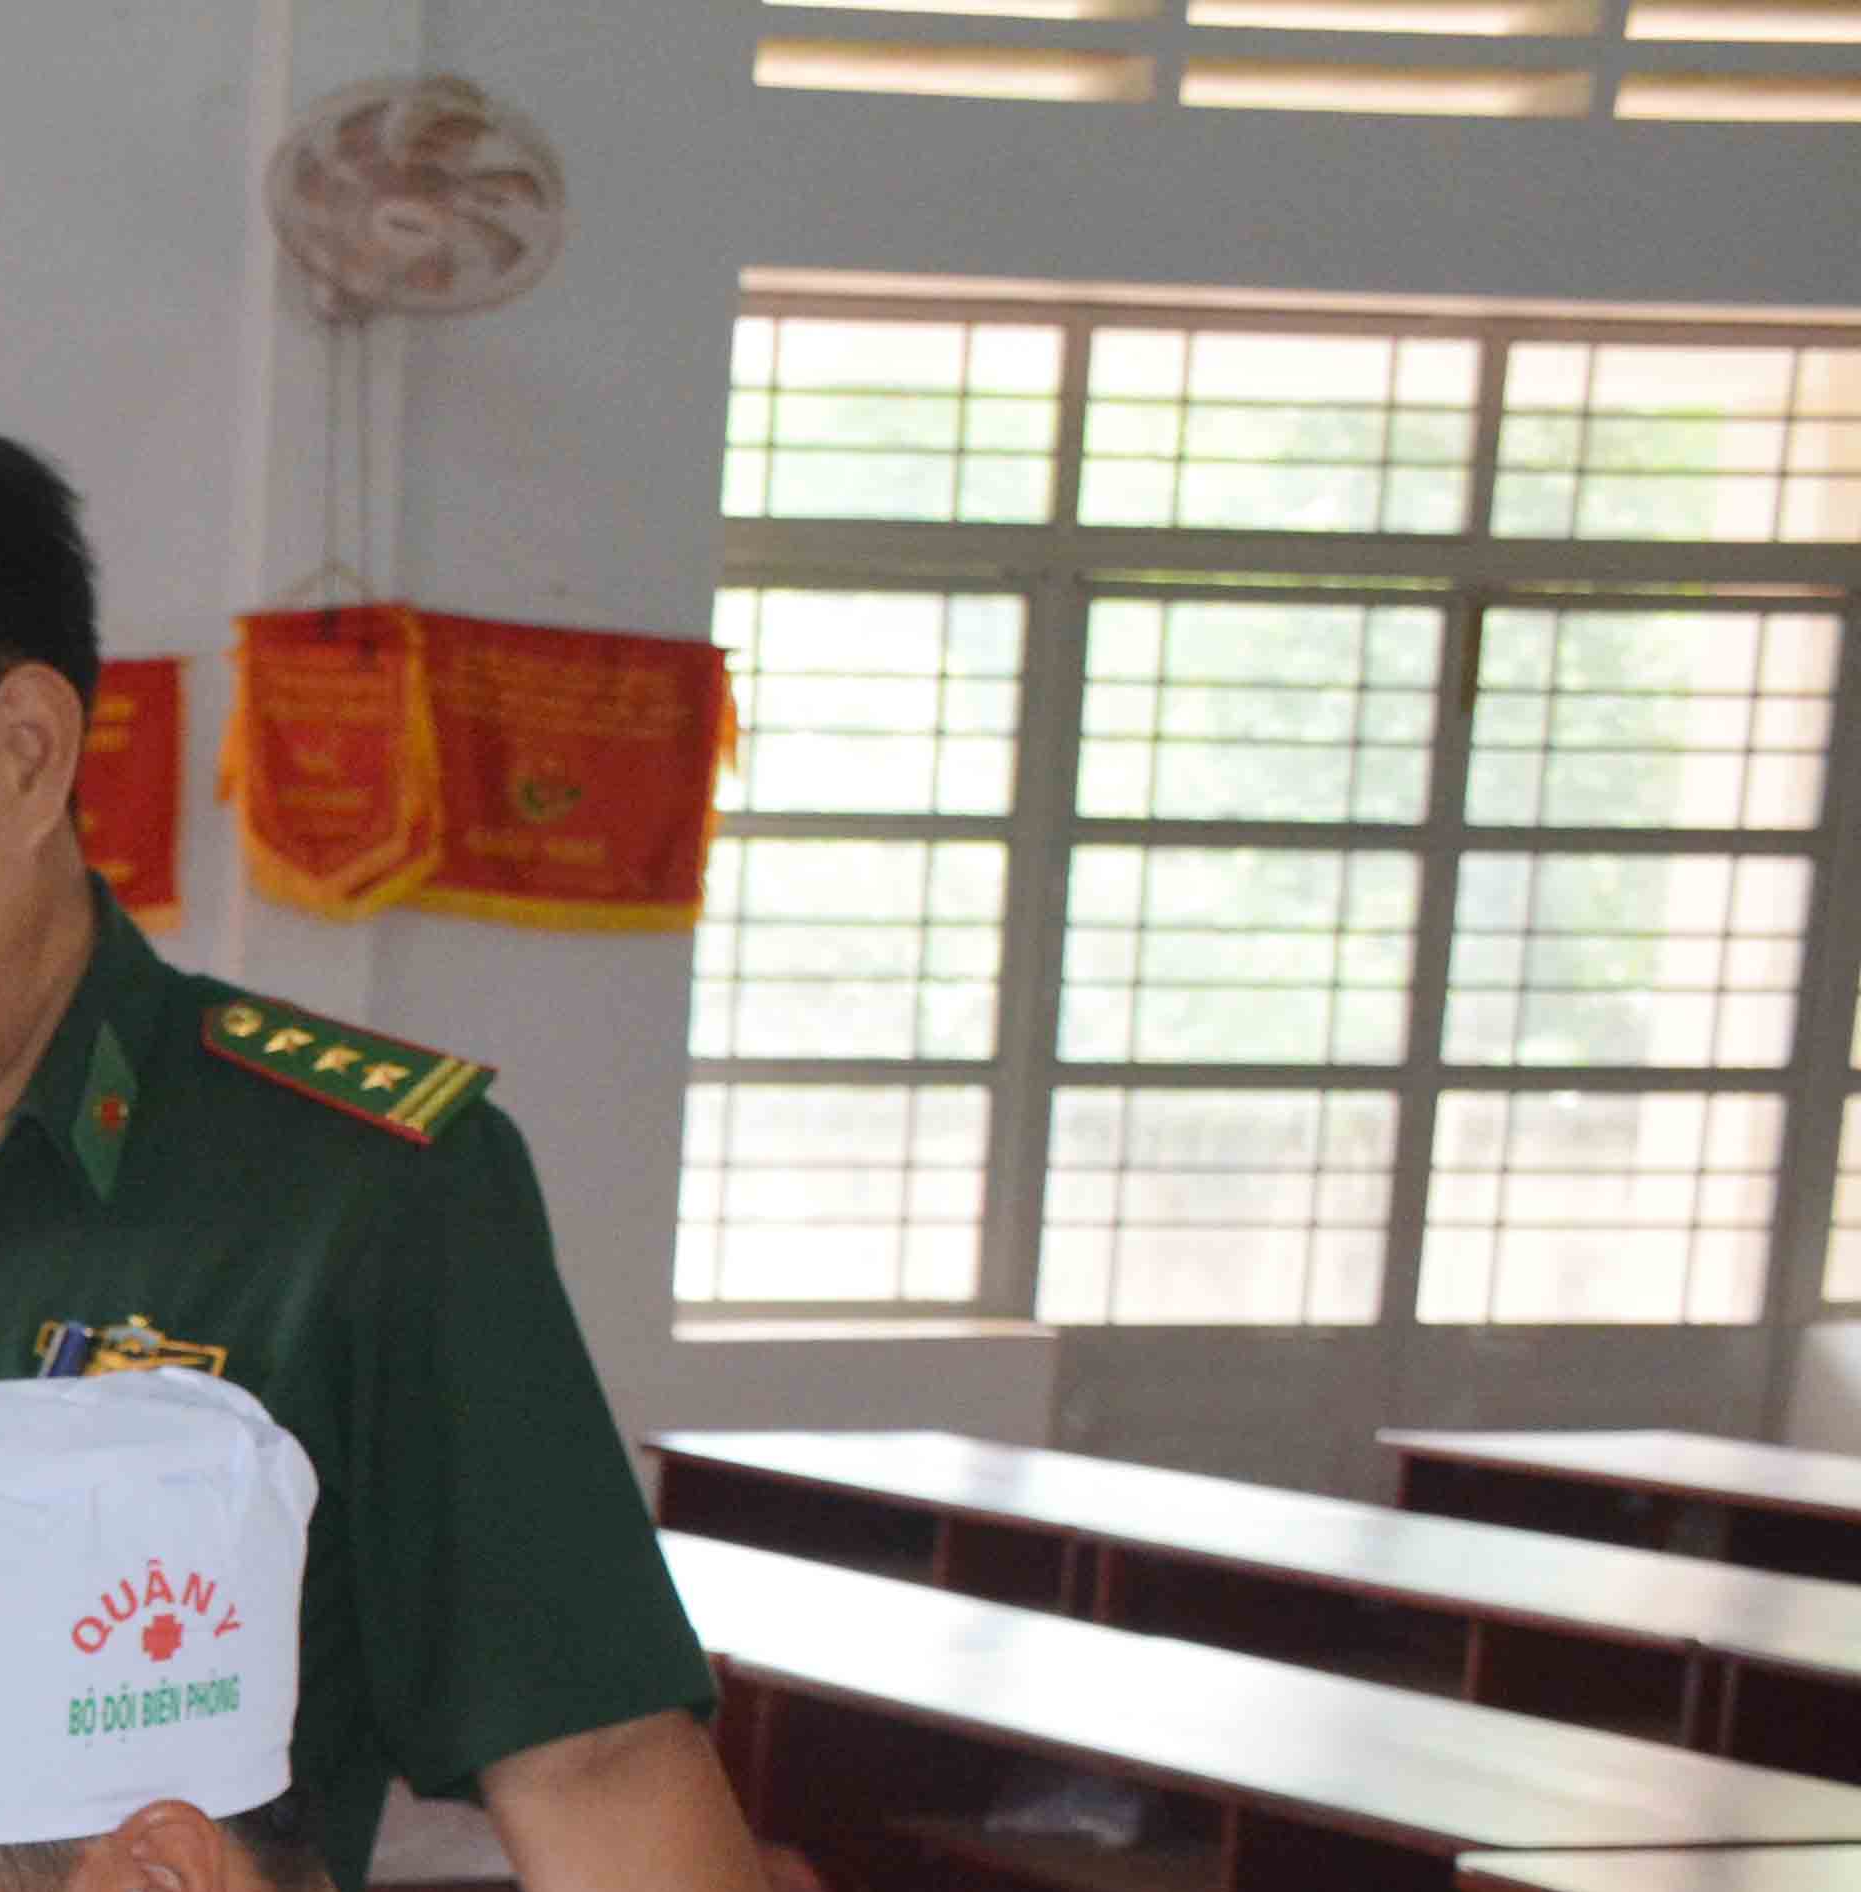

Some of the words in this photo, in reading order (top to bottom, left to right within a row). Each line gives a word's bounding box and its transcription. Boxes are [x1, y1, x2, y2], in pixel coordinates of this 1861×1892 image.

[72, 1556, 218, 1654] QUÂN
[213, 1602, 244, 1640] Y
[141, 1677, 182, 1729] BIÊN
